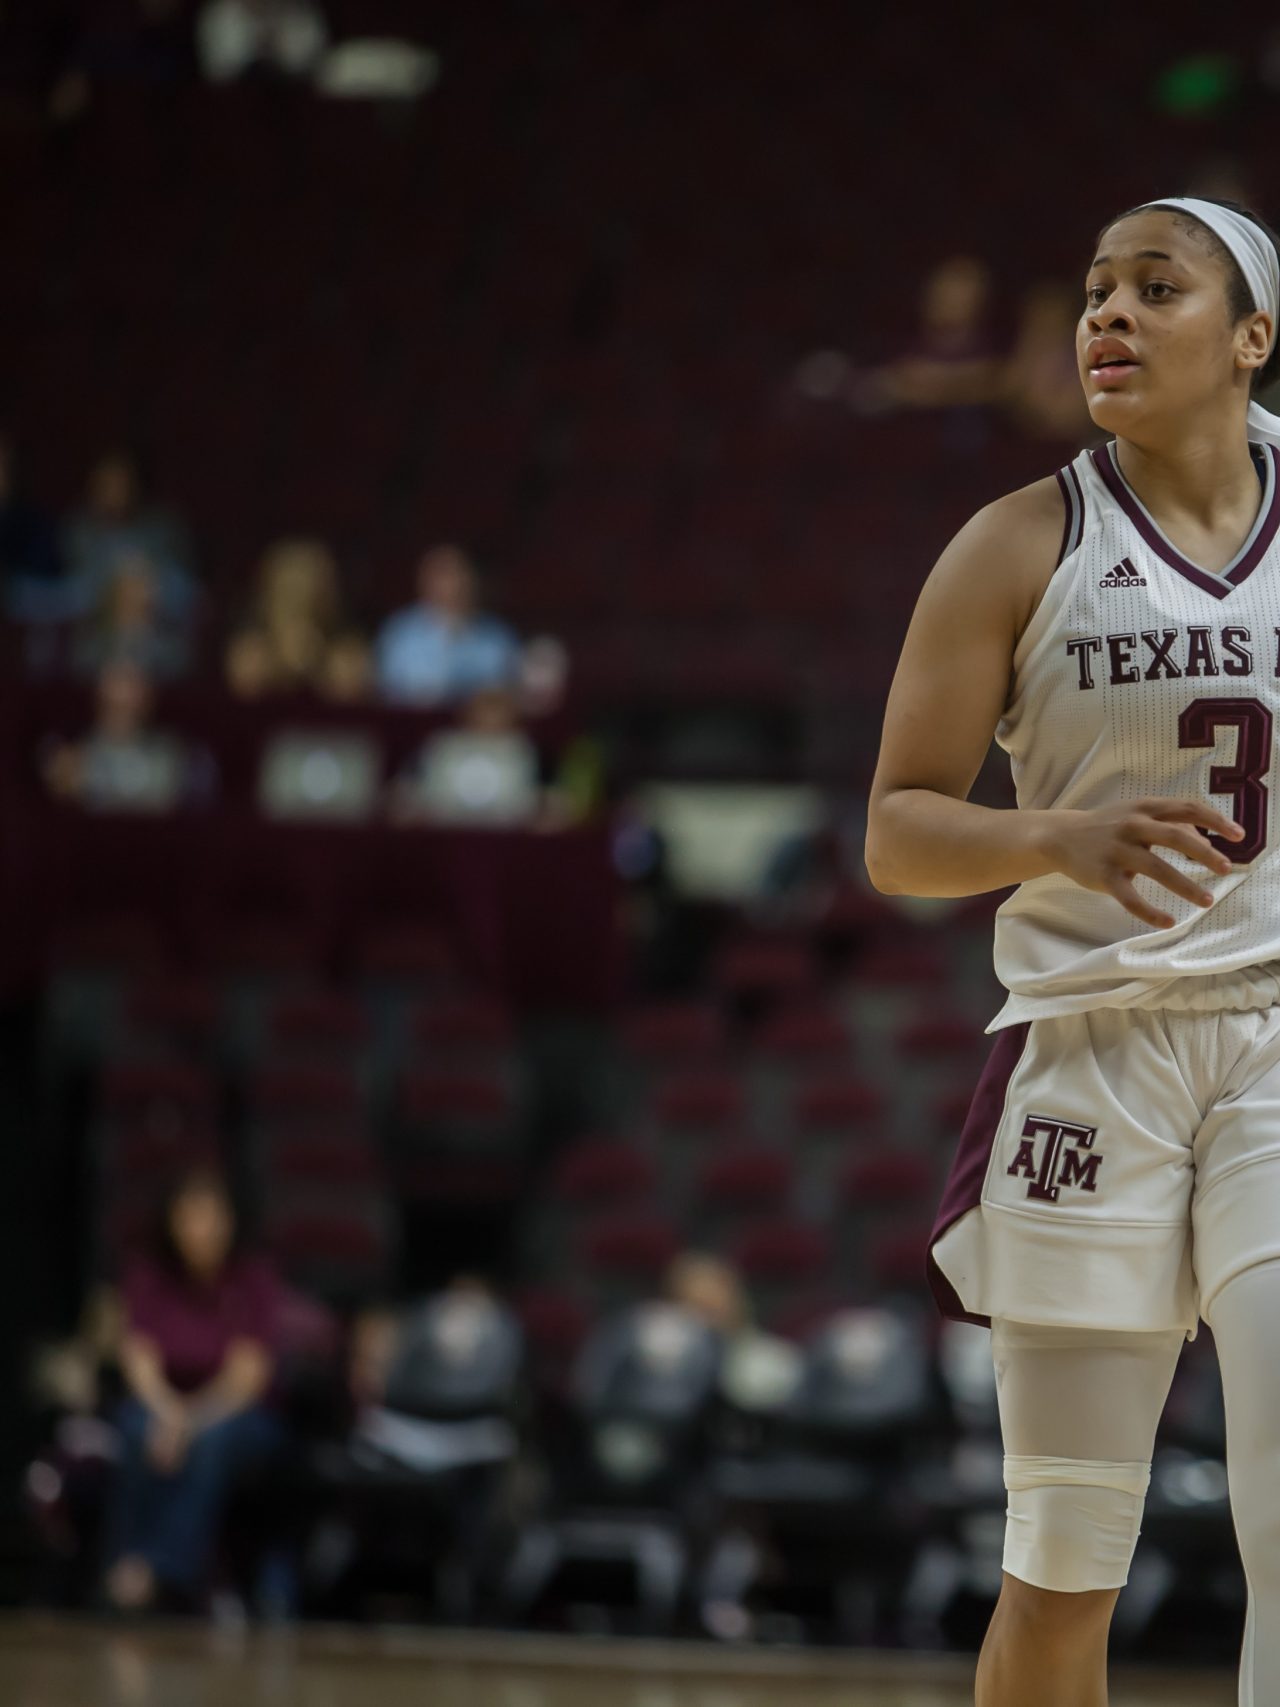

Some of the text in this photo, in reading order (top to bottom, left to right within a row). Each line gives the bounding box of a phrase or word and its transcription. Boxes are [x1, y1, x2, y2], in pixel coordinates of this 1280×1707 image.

[1099, 575, 1147, 588] adidas
[1066, 625, 1252, 690] TEXAS
[1178, 697, 1273, 864] 3
